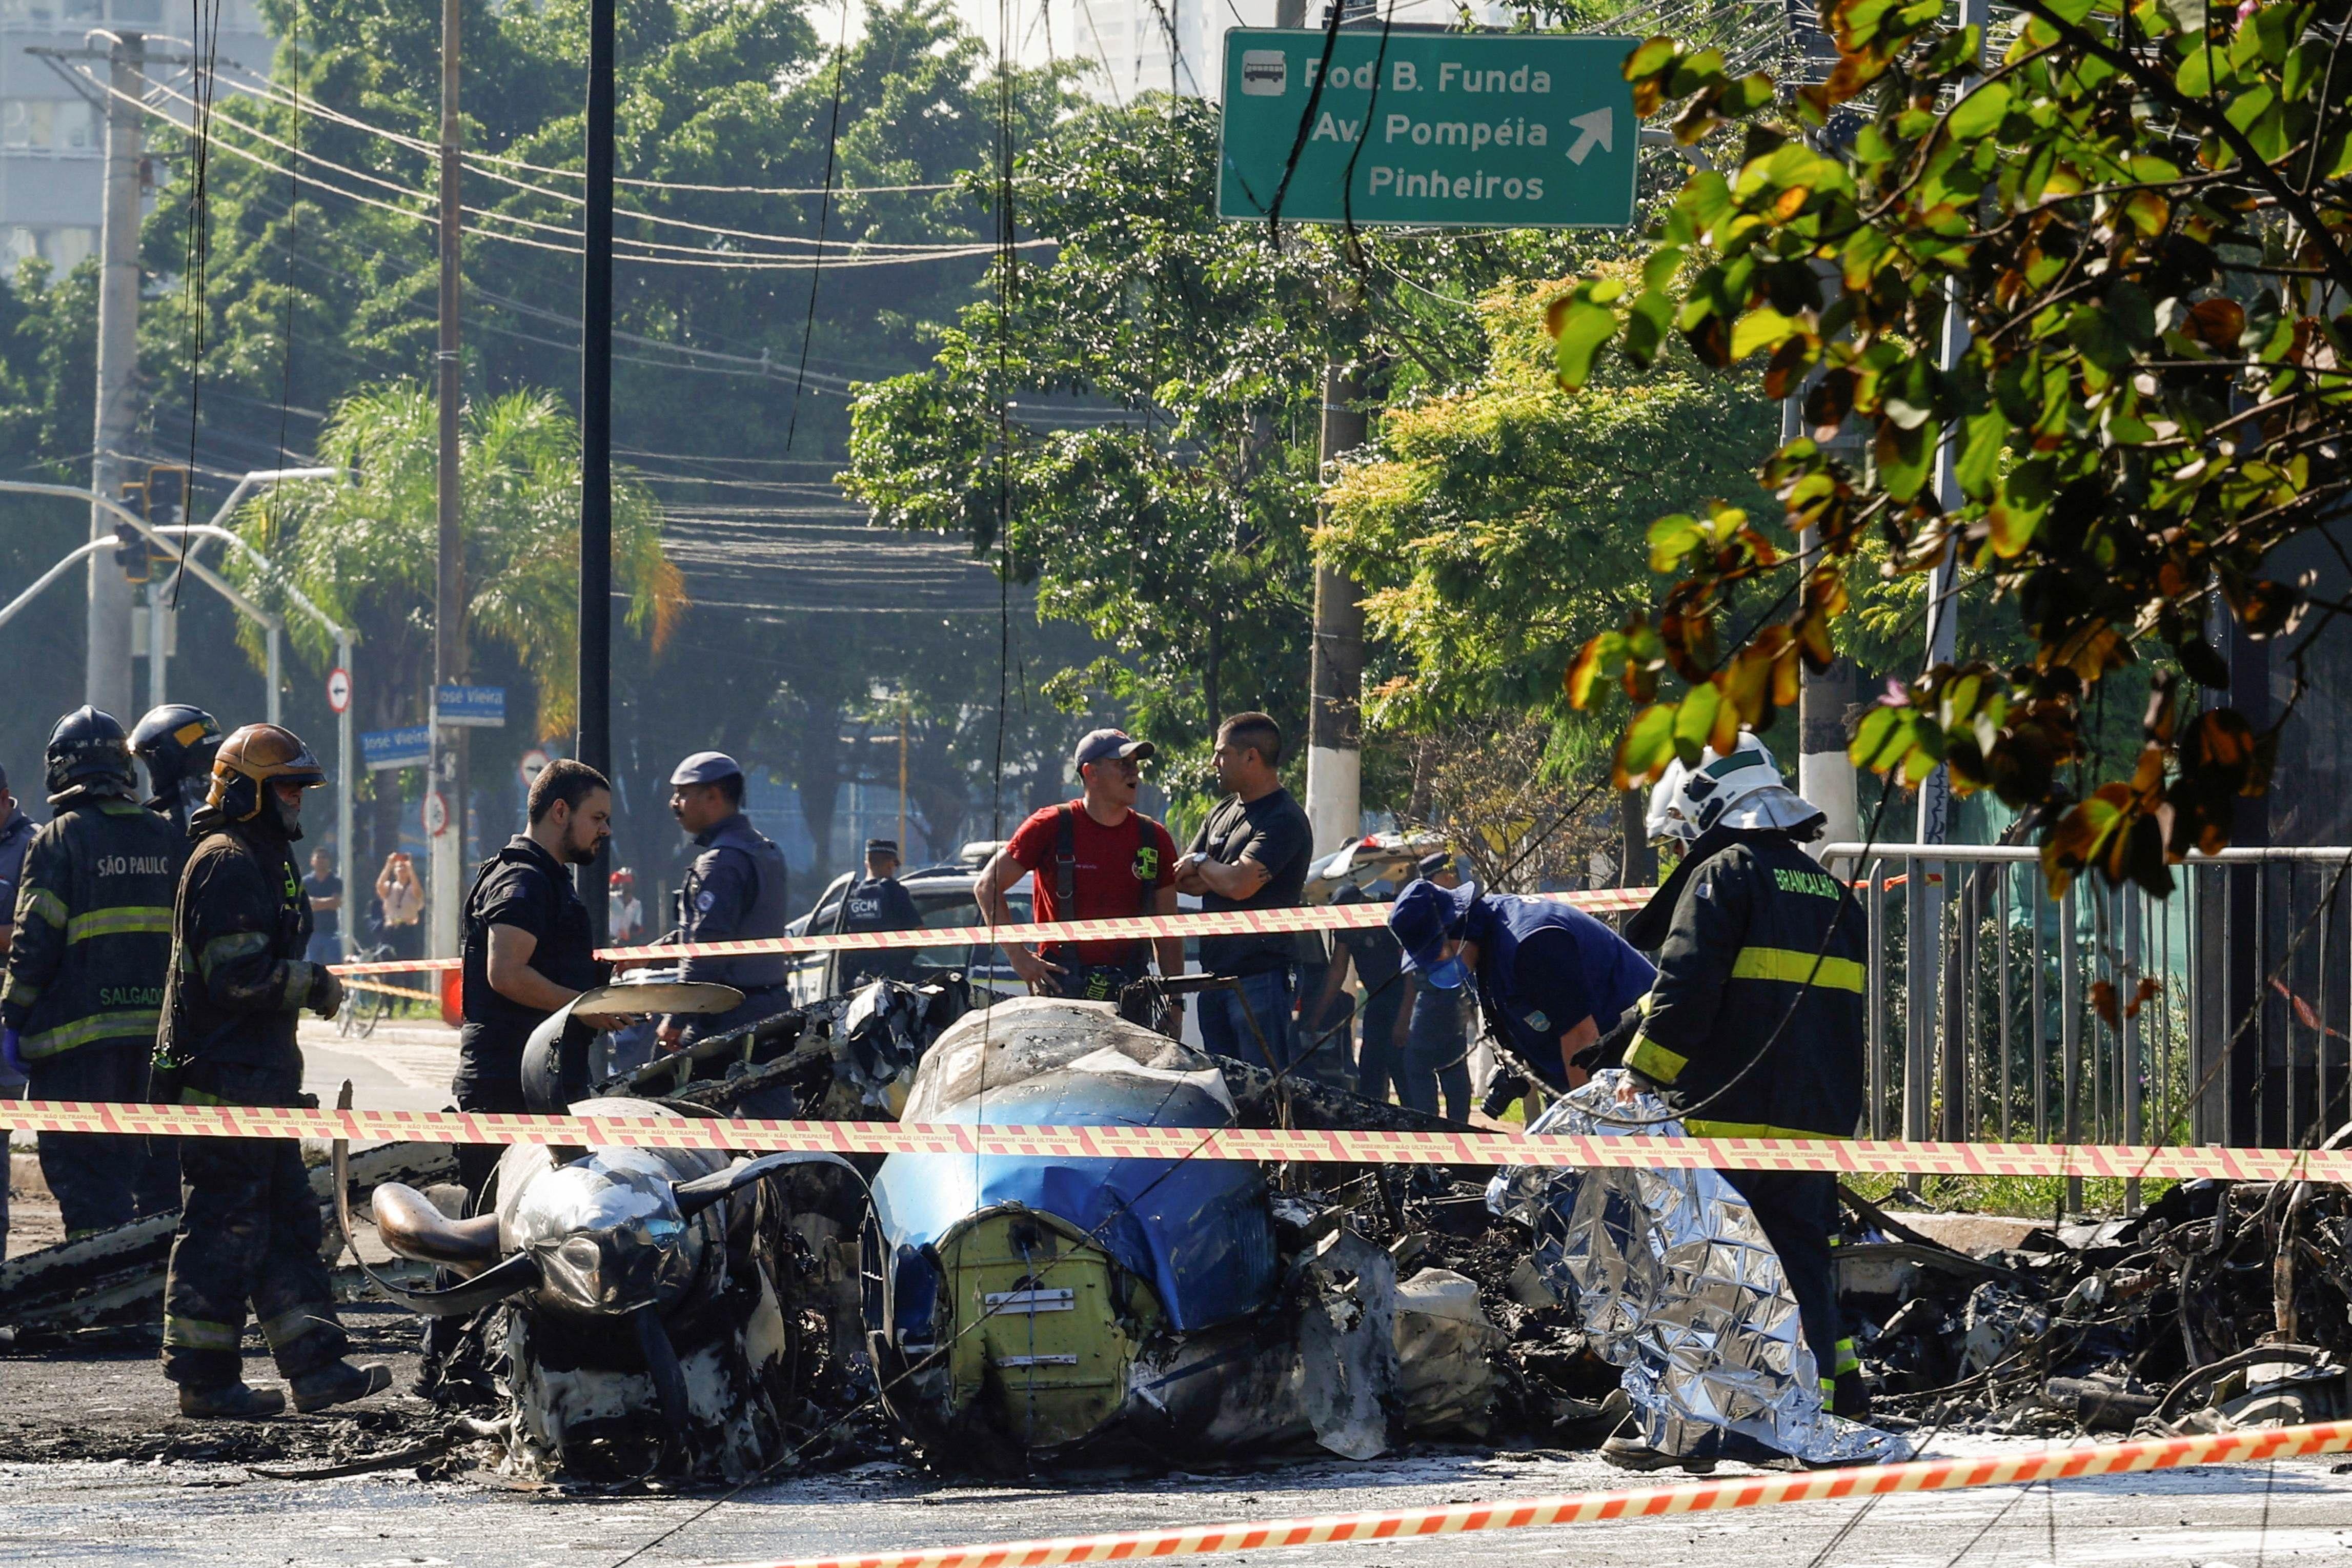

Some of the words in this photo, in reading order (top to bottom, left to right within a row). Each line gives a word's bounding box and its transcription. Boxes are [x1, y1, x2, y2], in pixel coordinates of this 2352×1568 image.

[1304, 58, 1381, 90] Rod.
[1393, 61, 1424, 92] B.
[1438, 63, 1551, 93] Funda
[1311, 112, 1361, 142] Av.
[1386, 113, 1548, 151] Pompéia
[1369, 166, 1544, 200] Pinheiros
[97, 854, 127, 877] SÃO
[851, 901, 877, 913] GCM
